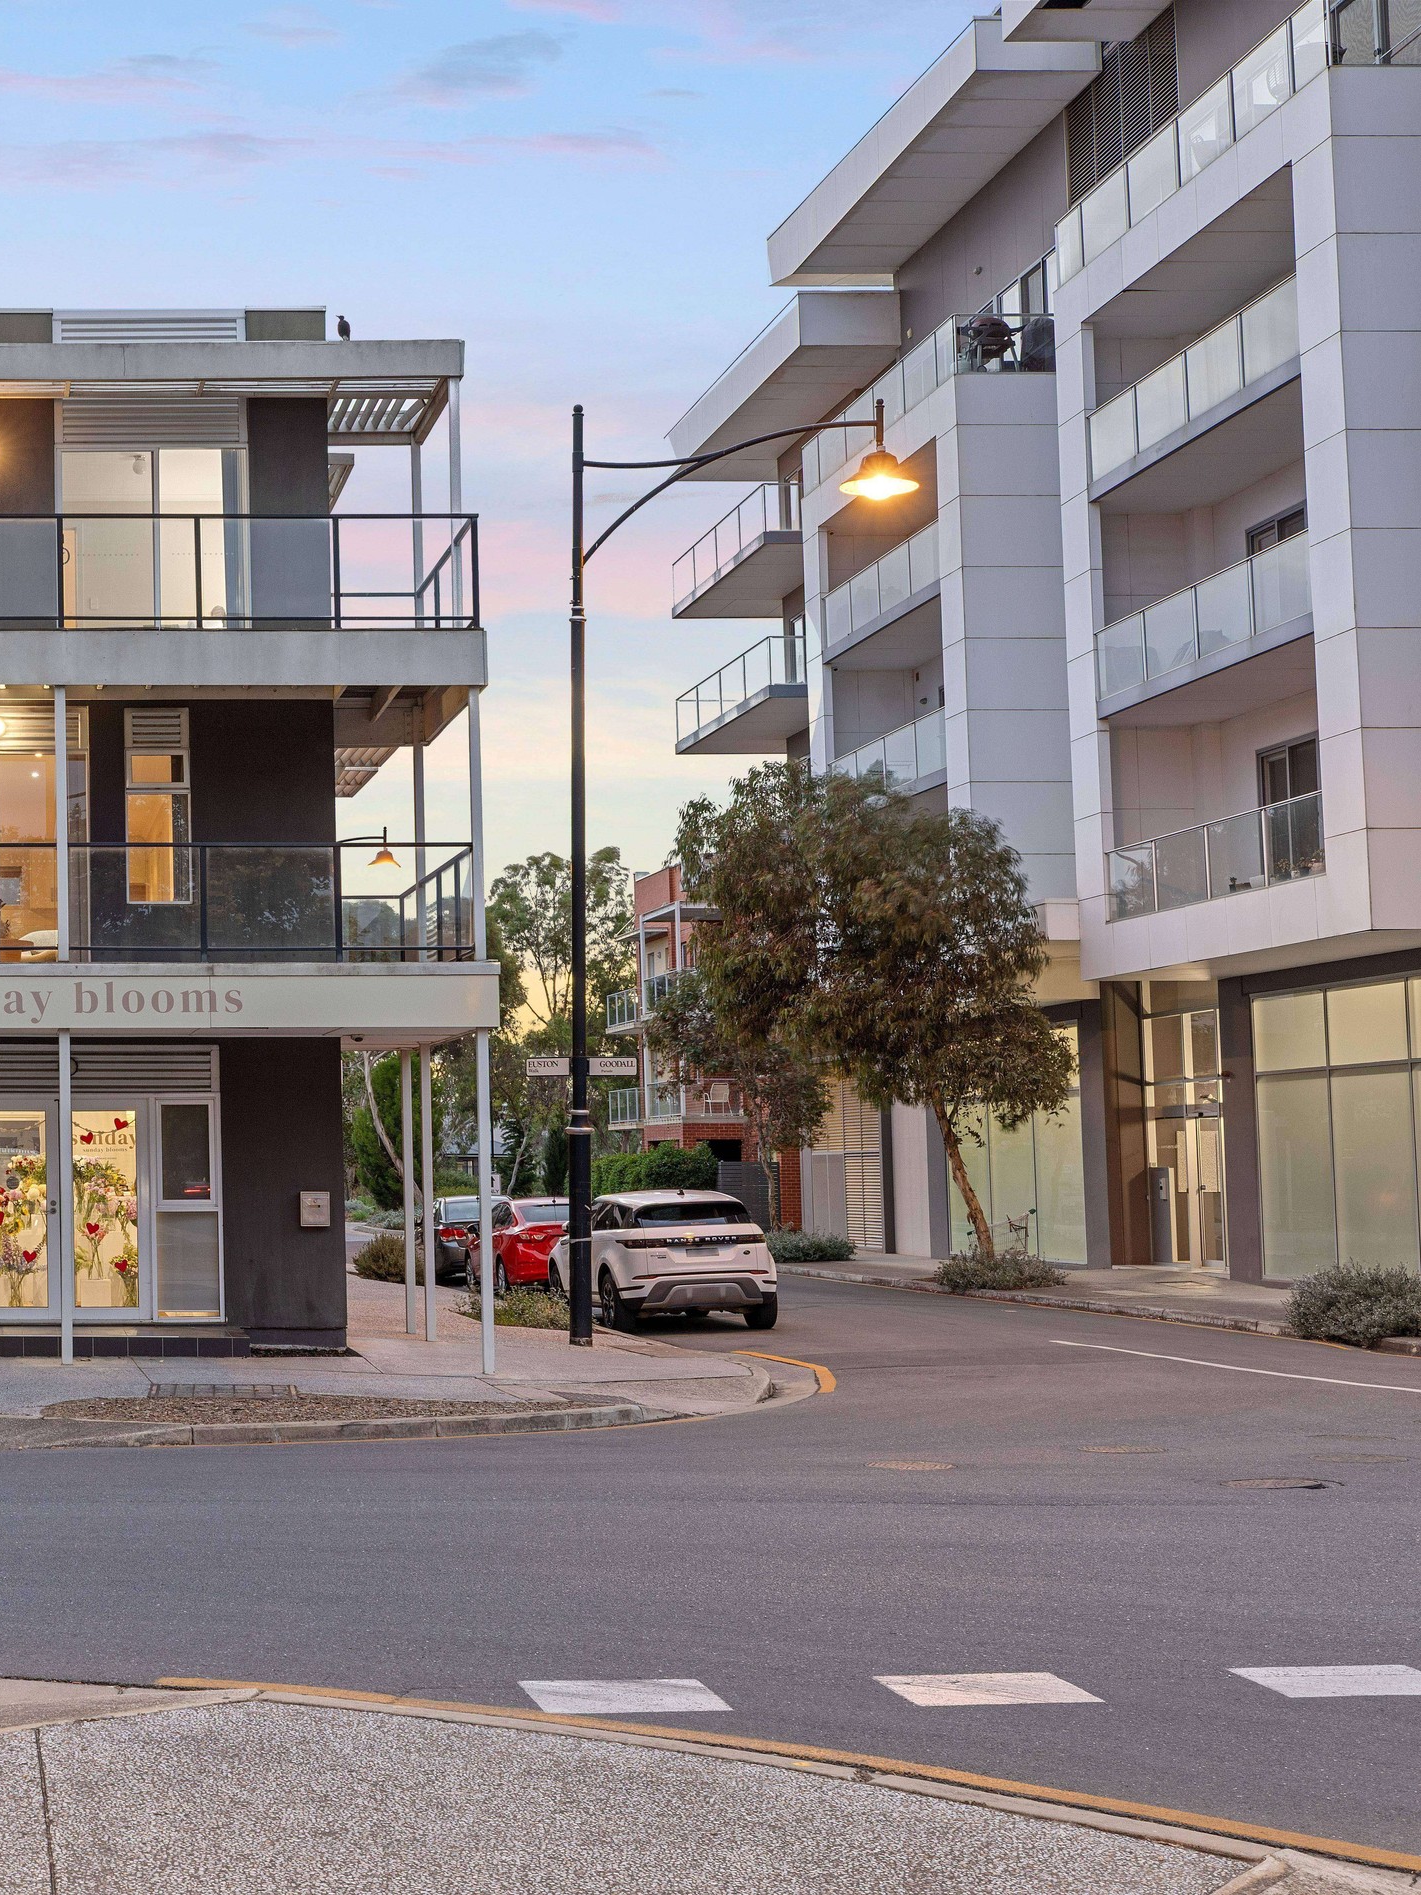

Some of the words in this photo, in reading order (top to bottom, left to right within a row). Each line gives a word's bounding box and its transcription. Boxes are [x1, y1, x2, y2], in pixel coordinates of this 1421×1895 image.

[73, 981, 244, 1014] blooms
[528, 1060, 559, 1068] EUSTON
[599, 1060, 635, 1068] GOODALL
[72, 1131, 136, 1149] snday
